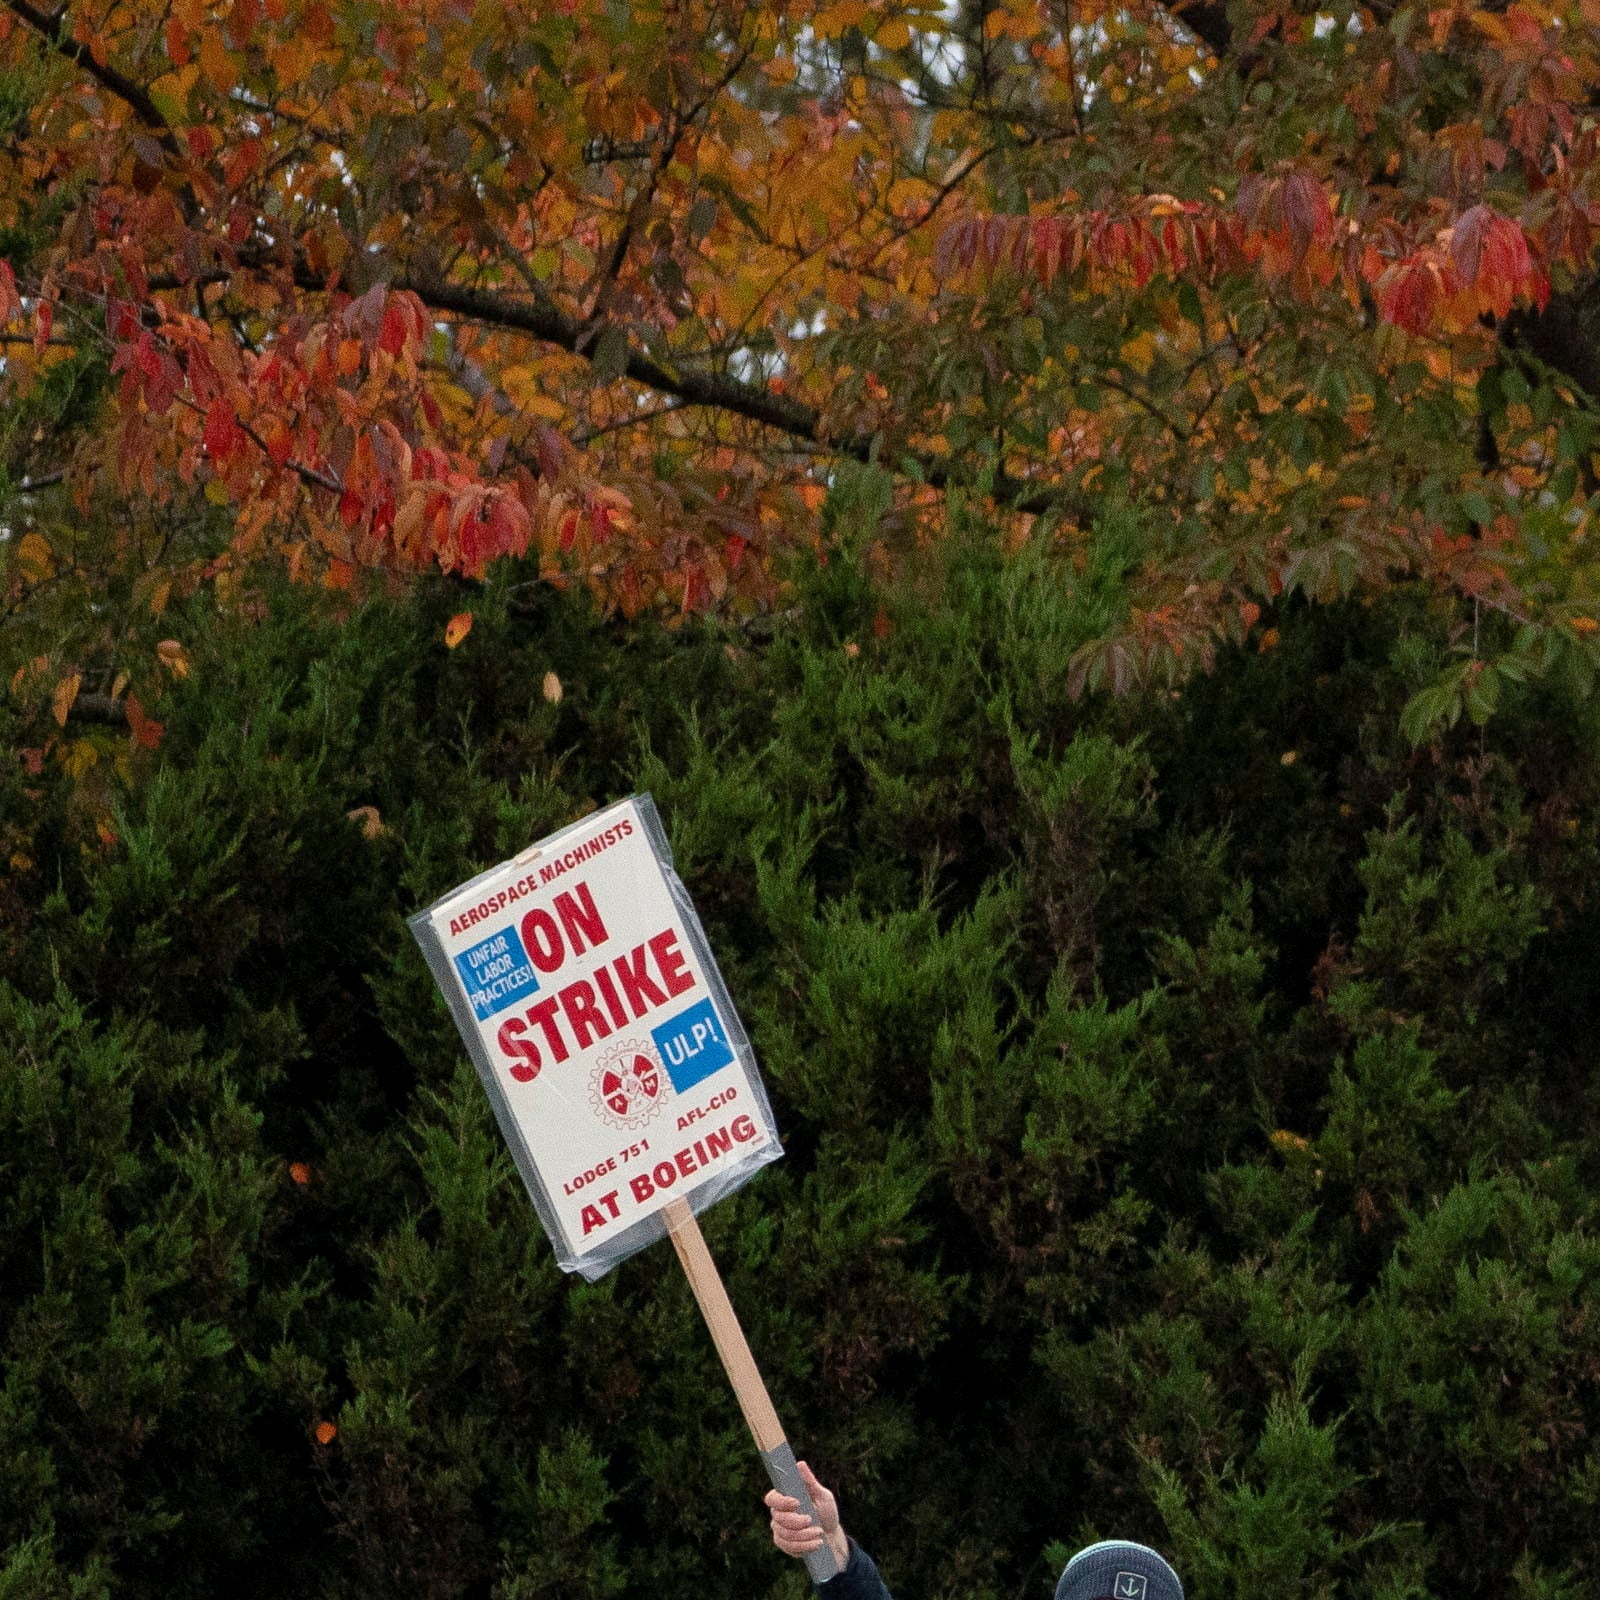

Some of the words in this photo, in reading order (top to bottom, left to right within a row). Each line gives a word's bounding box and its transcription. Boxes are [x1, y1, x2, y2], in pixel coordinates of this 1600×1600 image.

[449, 874, 539, 937] AEROSPACE
[541, 819, 634, 889] MACHINISTS
[467, 935, 507, 968] UNFAIR
[477, 954, 514, 986] LABOR
[521, 881, 609, 973] ON
[472, 965, 532, 1009] PRACTICES!
[497, 928, 697, 1083] STRIKE
[664, 1018, 719, 1067] ULP!
[564, 1159, 617, 1196] LODGE
[620, 1139, 650, 1163] 751
[676, 1087, 738, 1132] AFL-CIO
[579, 1190, 620, 1236] AT
[633, 1114, 756, 1204] BOEING
